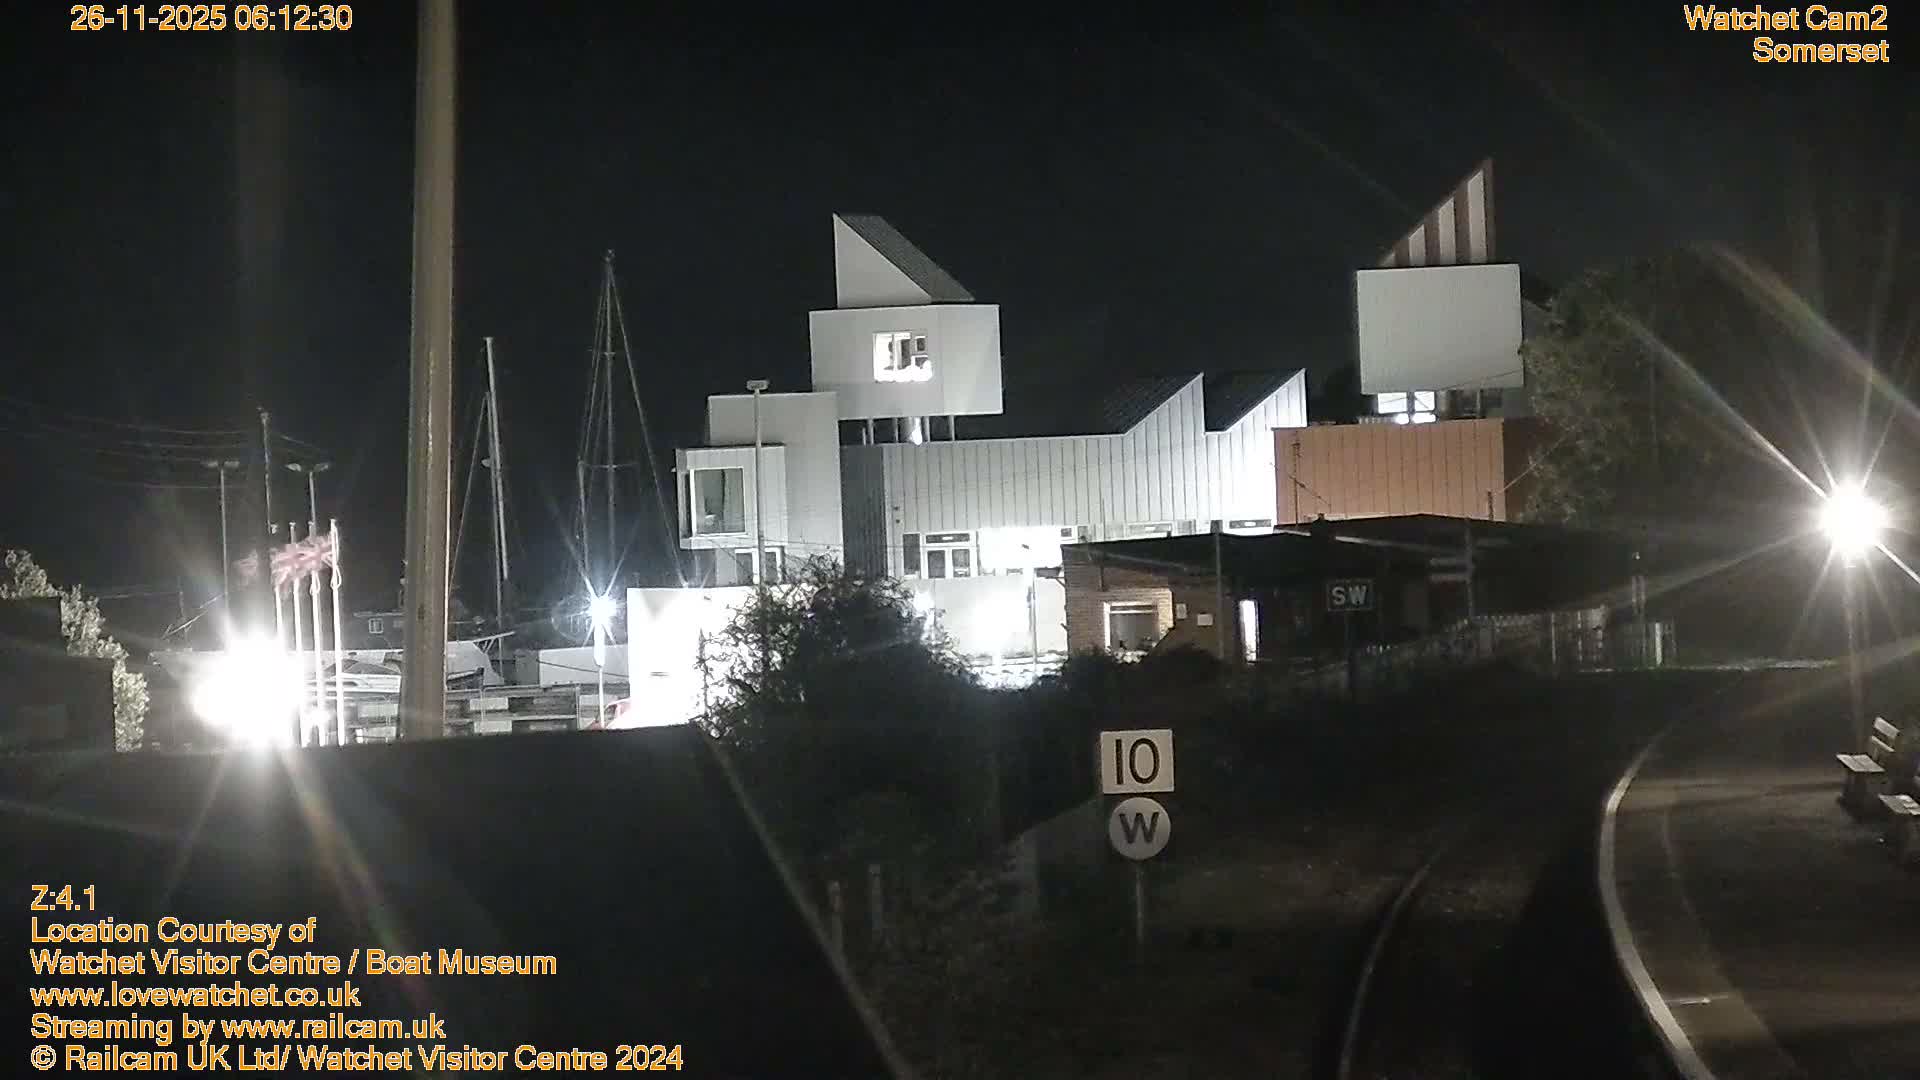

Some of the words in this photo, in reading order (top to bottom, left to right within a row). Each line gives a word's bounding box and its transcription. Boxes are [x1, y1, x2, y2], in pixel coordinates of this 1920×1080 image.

[1331, 585, 1367, 606] SW
[1115, 737, 1160, 785] 10
[1119, 811, 1160, 844] W
